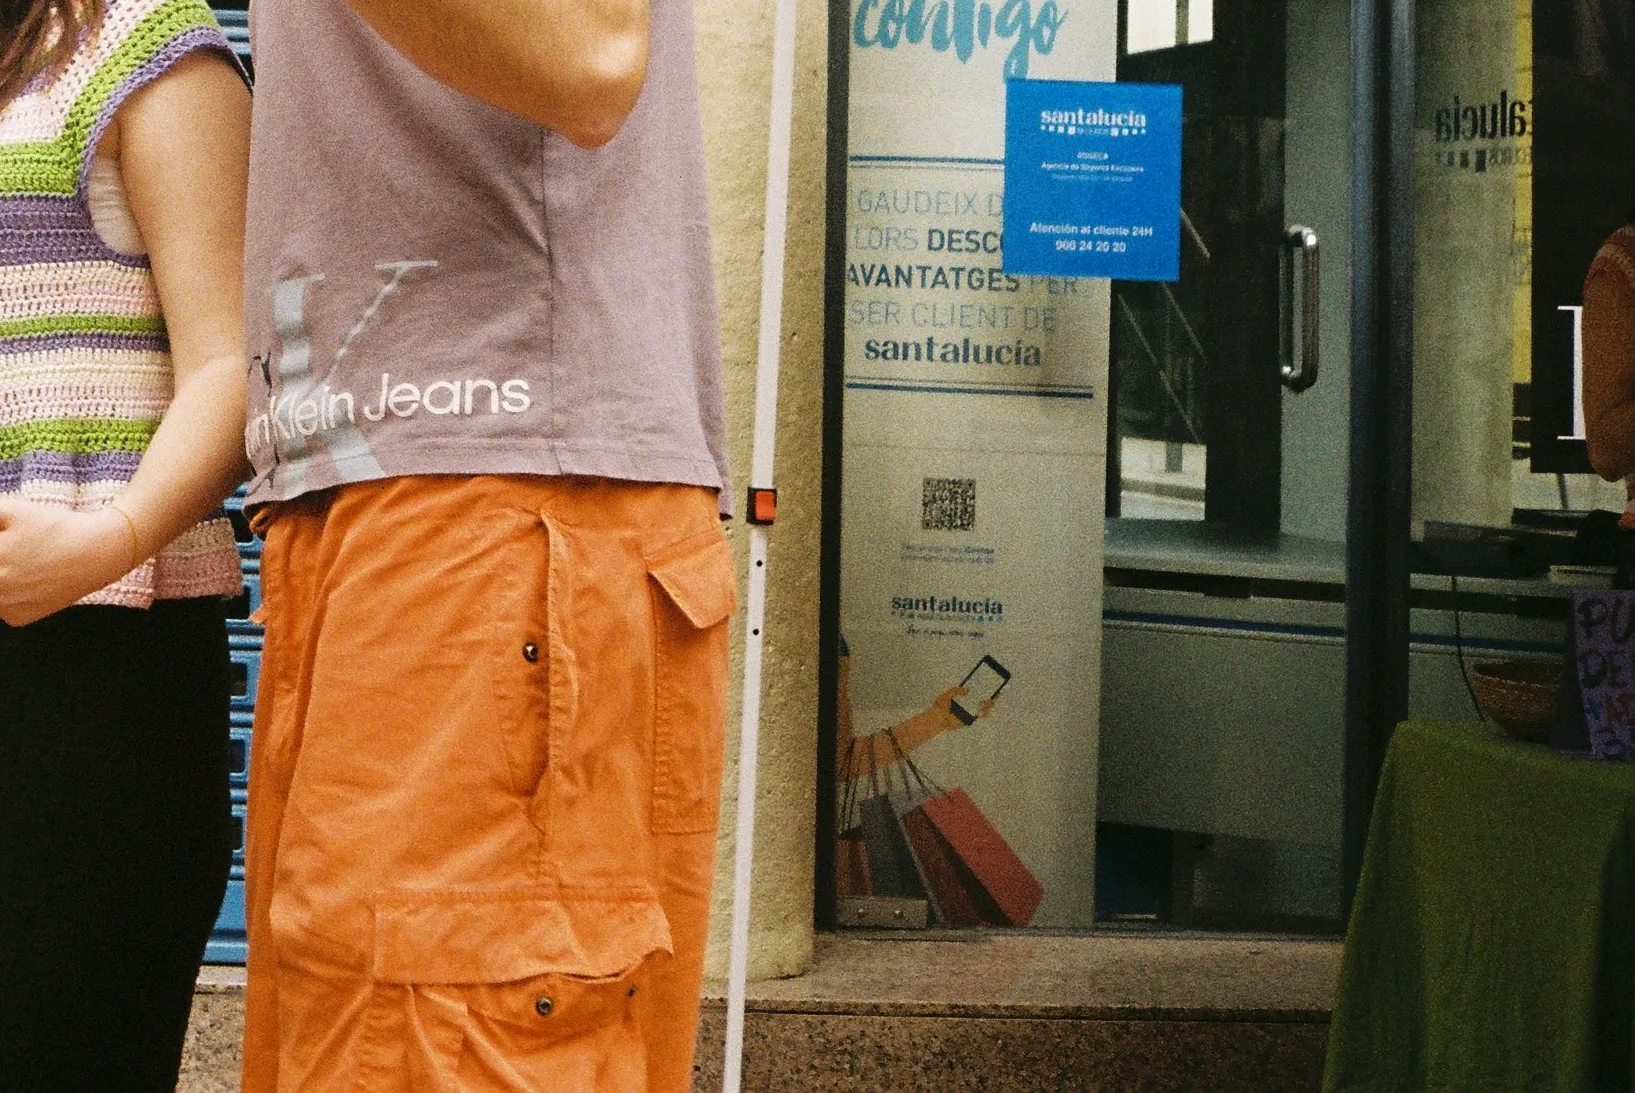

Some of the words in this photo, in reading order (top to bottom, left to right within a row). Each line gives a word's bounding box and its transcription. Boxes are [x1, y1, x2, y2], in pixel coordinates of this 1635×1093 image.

[857, 189, 978, 216] GAUDEIX
[927, 228, 1004, 253] DESC
[1080, 224, 1091, 235] al
[1079, 240, 1093, 251] 24
[851, 300, 901, 326] SER
[911, 302, 1015, 330] CLIENT
[1023, 306, 1058, 333] DE
[364, 373, 532, 423] Jeans
